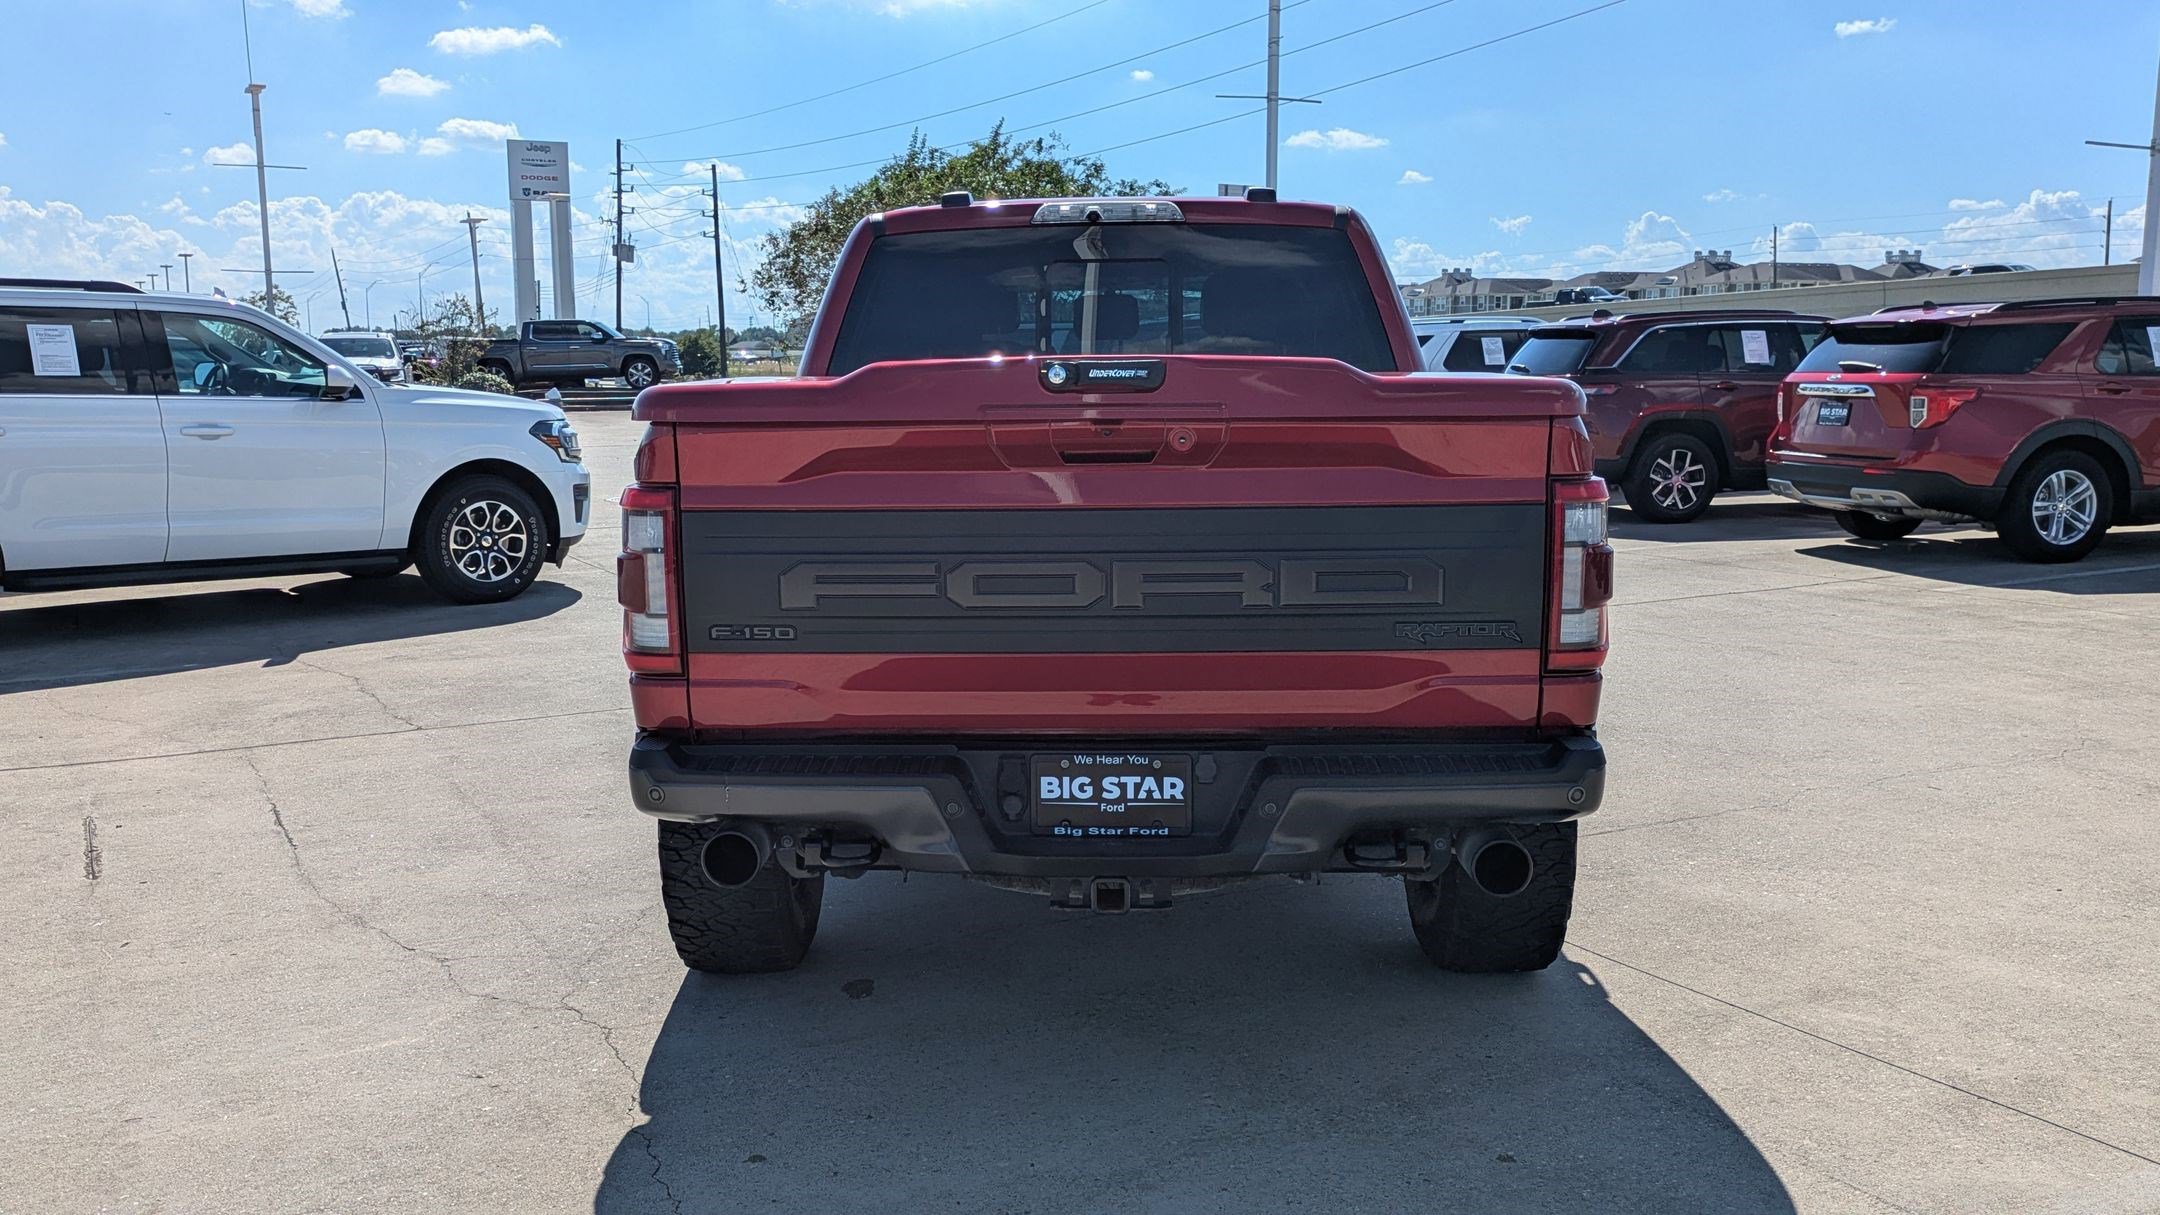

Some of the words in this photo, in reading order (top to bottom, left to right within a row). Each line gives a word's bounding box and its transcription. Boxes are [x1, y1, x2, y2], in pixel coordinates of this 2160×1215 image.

[526, 143, 551, 154] Jeep
[1820, 407, 1831, 416] BIG
[1831, 407, 1848, 416] STAR
[778, 558, 1444, 610] FORD
[710, 626, 796, 640] F-150
[1395, 622, 1522, 642] RAPTOR
[1074, 754, 1093, 765] We
[1096, 754, 1125, 765] Hear
[1127, 754, 1149, 765] You
[1040, 775, 1093, 799] BIG
[1101, 775, 1185, 800] STAR
[1100, 803, 1125, 812] Ford
[1054, 827, 1083, 837] Big
[1088, 827, 1124, 836] Star
[1129, 827, 1169, 836] Ford
